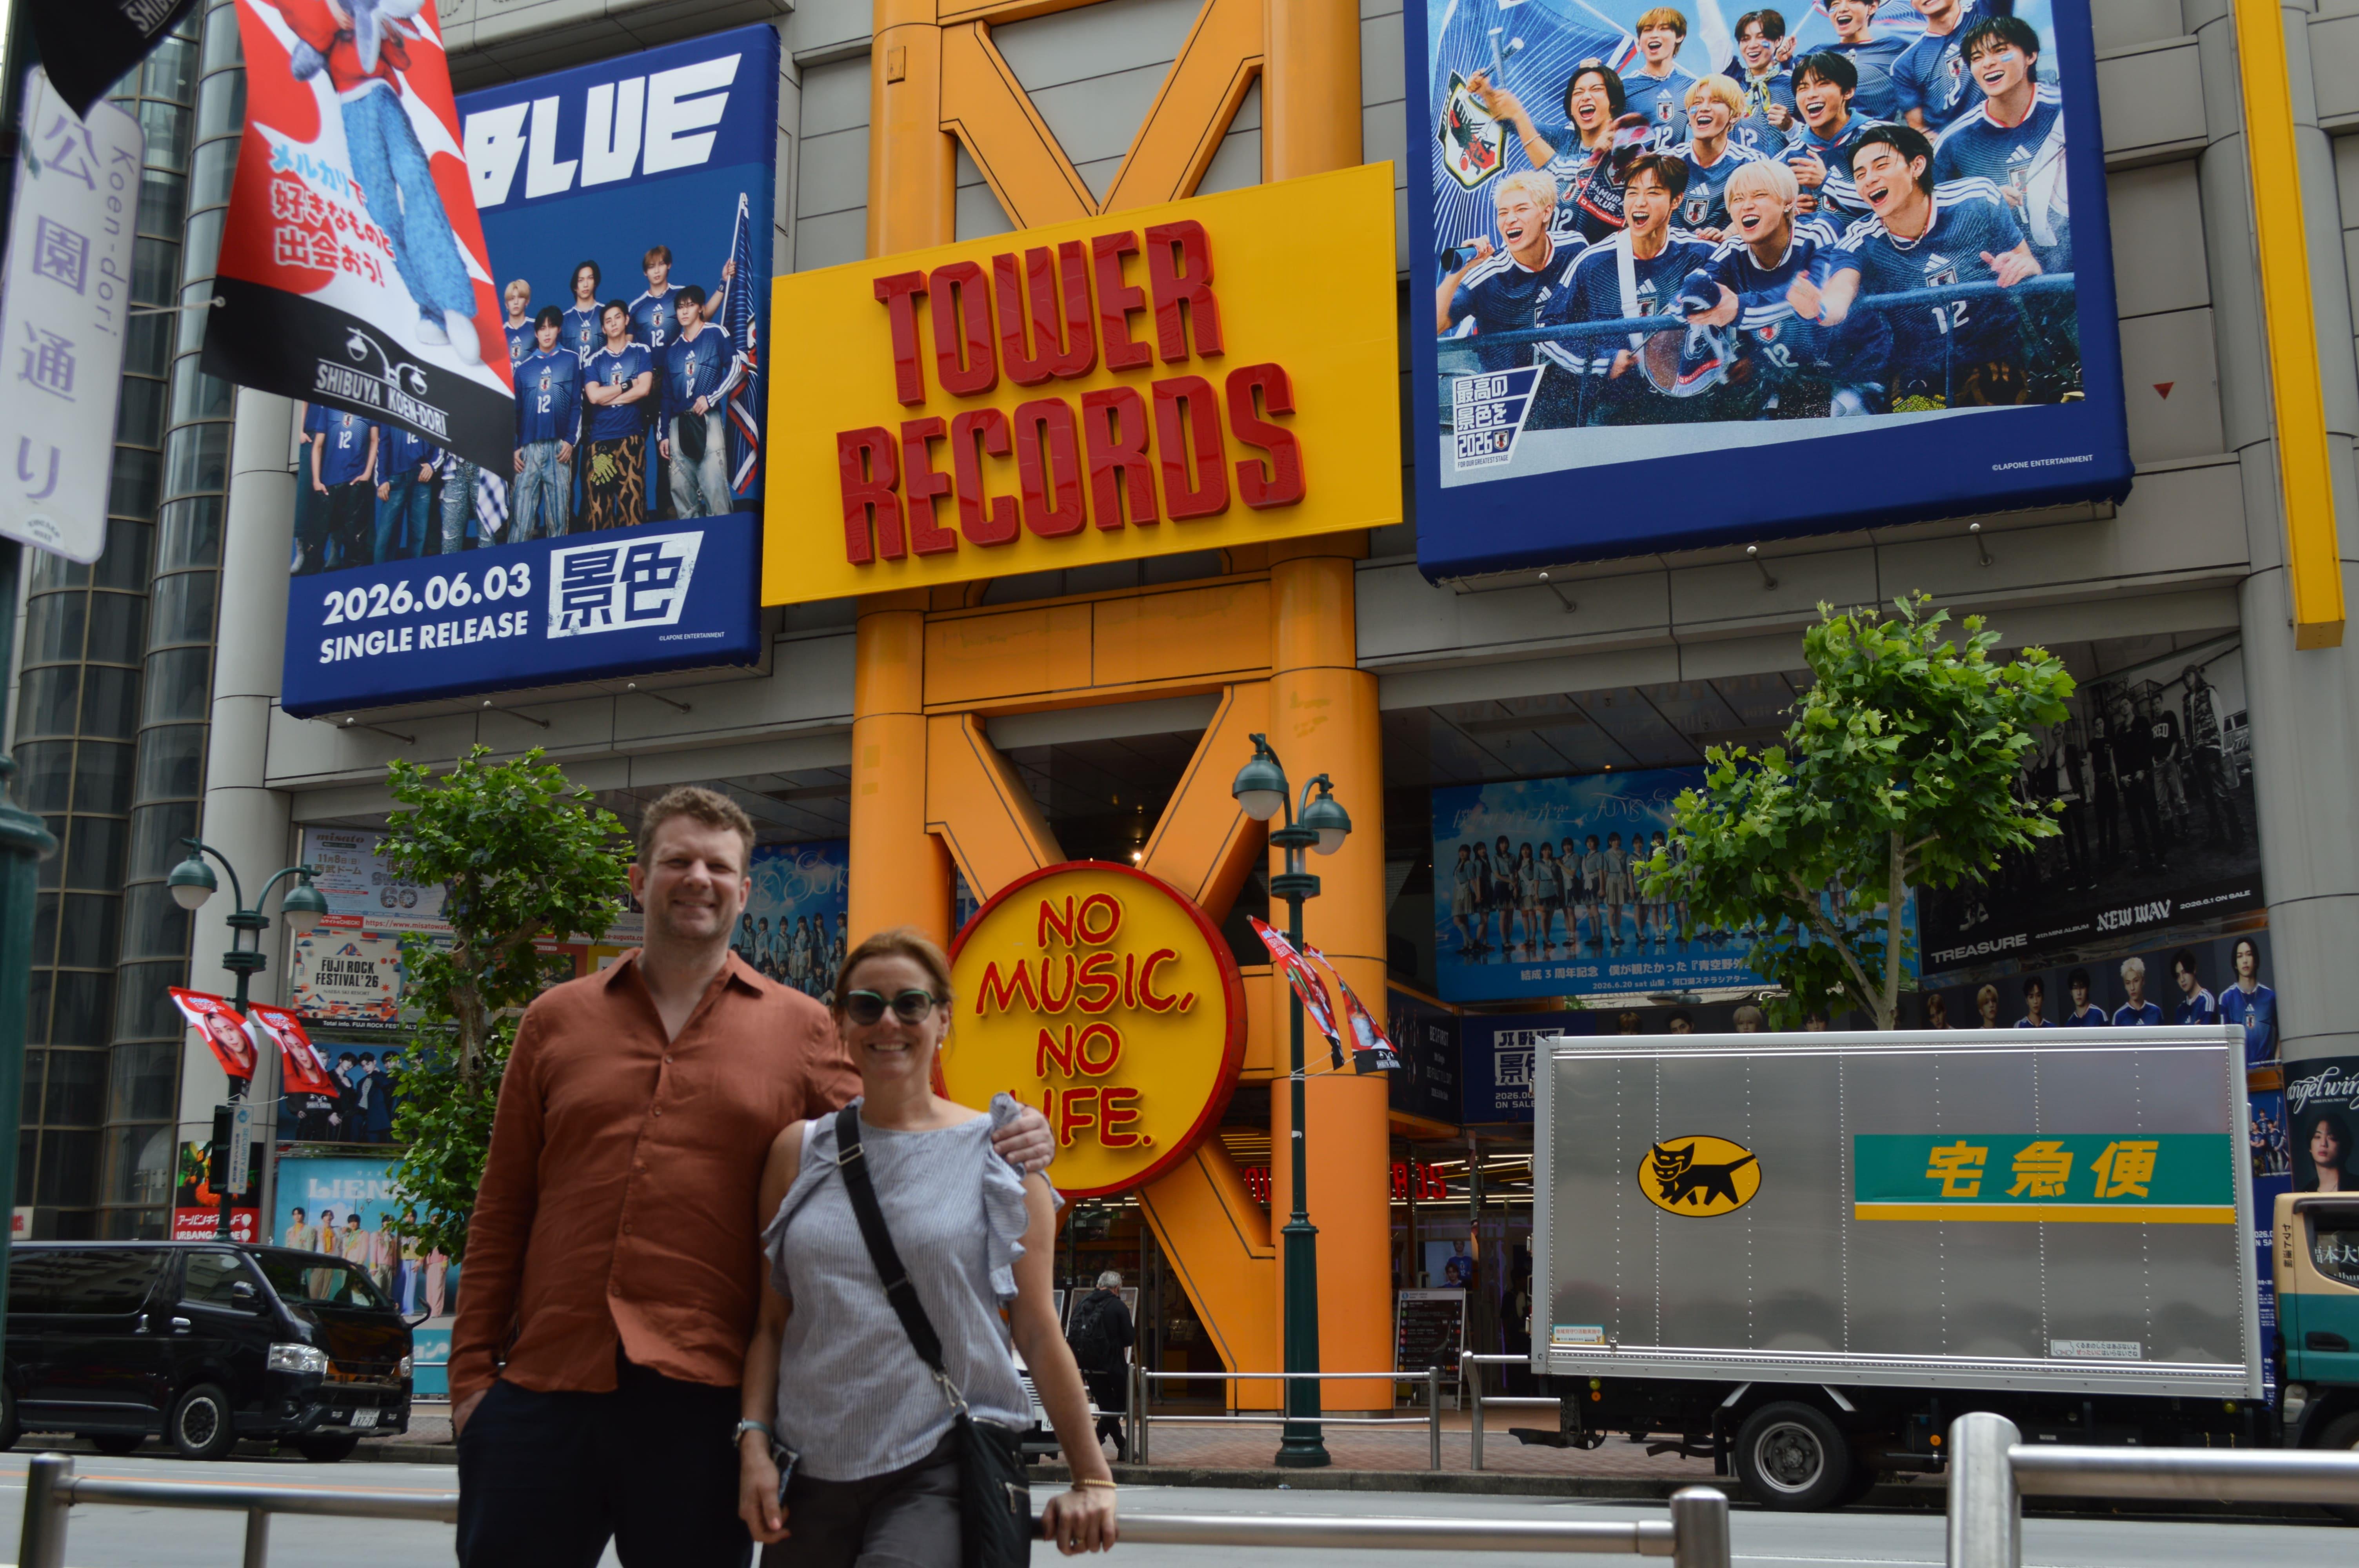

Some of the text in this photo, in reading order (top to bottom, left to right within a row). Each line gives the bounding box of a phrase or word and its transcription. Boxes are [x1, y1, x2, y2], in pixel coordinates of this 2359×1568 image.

[463, 53, 741, 209] BLUE
[1654, 127, 1673, 149] 12
[1738, 127, 1758, 147] 12
[273, 143, 367, 207] メルカリで
[275, 181, 395, 259] 好きなものと
[1551, 208, 1572, 230] 12
[1593, 194, 1616, 212] BLUE
[94, 144, 137, 338] Koen-dori
[16, 111, 101, 500] 公園通り
[873, 220, 1225, 407] TOWER
[1932, 300, 1969, 334] 12
[651, 329, 664, 348] 12
[1763, 343, 1799, 367] 12
[316, 363, 447, 436] SHIBUYA KOEN-DORI
[537, 395, 551, 414] 12
[687, 377, 695, 398] 12
[1457, 375, 1508, 405] 最高の
[1458, 403, 1507, 430] 景色を
[338, 431, 352, 449] 12
[1459, 431, 1493, 458] 2026
[836, 363, 1306, 566] RECORDS
[1475, 457, 1495, 465] GREATEST
[1992, 454, 2093, 471] ©LAPONE ENTERTAINMENT
[322, 563, 531, 626] 2026.06.03
[559, 541, 685, 630] 景色
[319, 610, 529, 665] SINGLE RELEASE
[659, 631, 725, 642] ©LAPONE ENTERTAINMENT
[316, 832, 364, 844] misato
[1038, 891, 1123, 949] NO
[1931, 933, 2028, 964] TREASURE
[2063, 924, 2090, 934] ALBUM
[2179, 898, 2214, 910] 2026.6.1
[2229, 890, 2251, 900] SALE
[322, 960, 374, 974] FUJI ROCK
[976, 948, 1197, 1016] MUSIC,
[1592, 982, 1632, 990] 2026.6.20
[1036, 1022, 1123, 1078] NO
[2287, 1066, 2359, 1114] angel win
[1009, 1086, 1156, 1148] IFE.
[240, 1127, 249, 1166] SECURITY
[1925, 1140, 2159, 1198] 宅急便
[2282, 1223, 2293, 1268] ヤマト運輸
